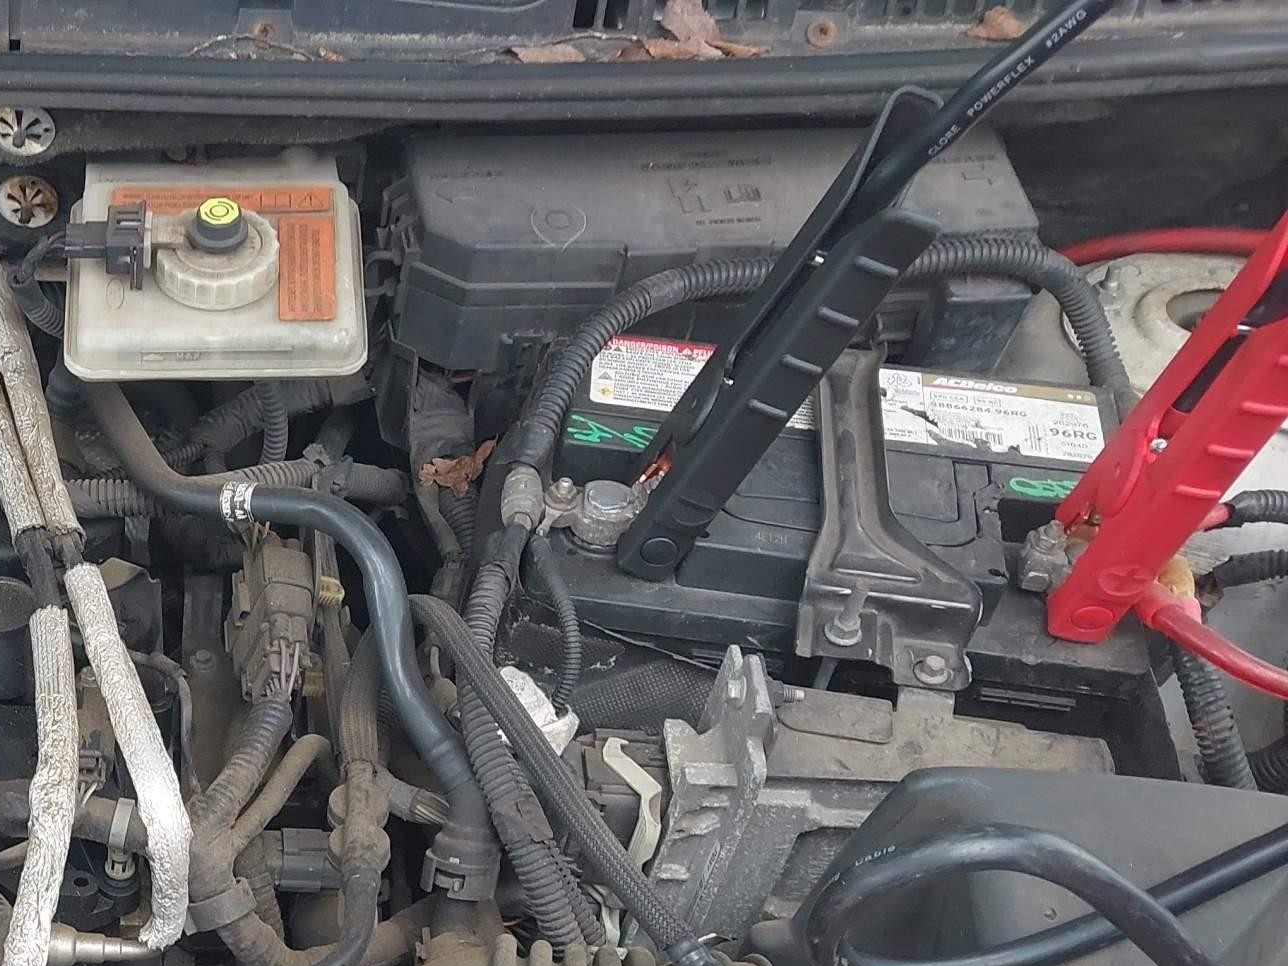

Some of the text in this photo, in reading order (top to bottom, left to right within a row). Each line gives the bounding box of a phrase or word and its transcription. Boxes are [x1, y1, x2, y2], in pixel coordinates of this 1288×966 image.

[927, 123, 961, 157] CLORE
[966, 55, 1035, 118] POWERFLEX
[176, 351, 201, 361] MAX
[932, 377, 1018, 394] ACDelco
[1049, 427, 1098, 441] 96RG
